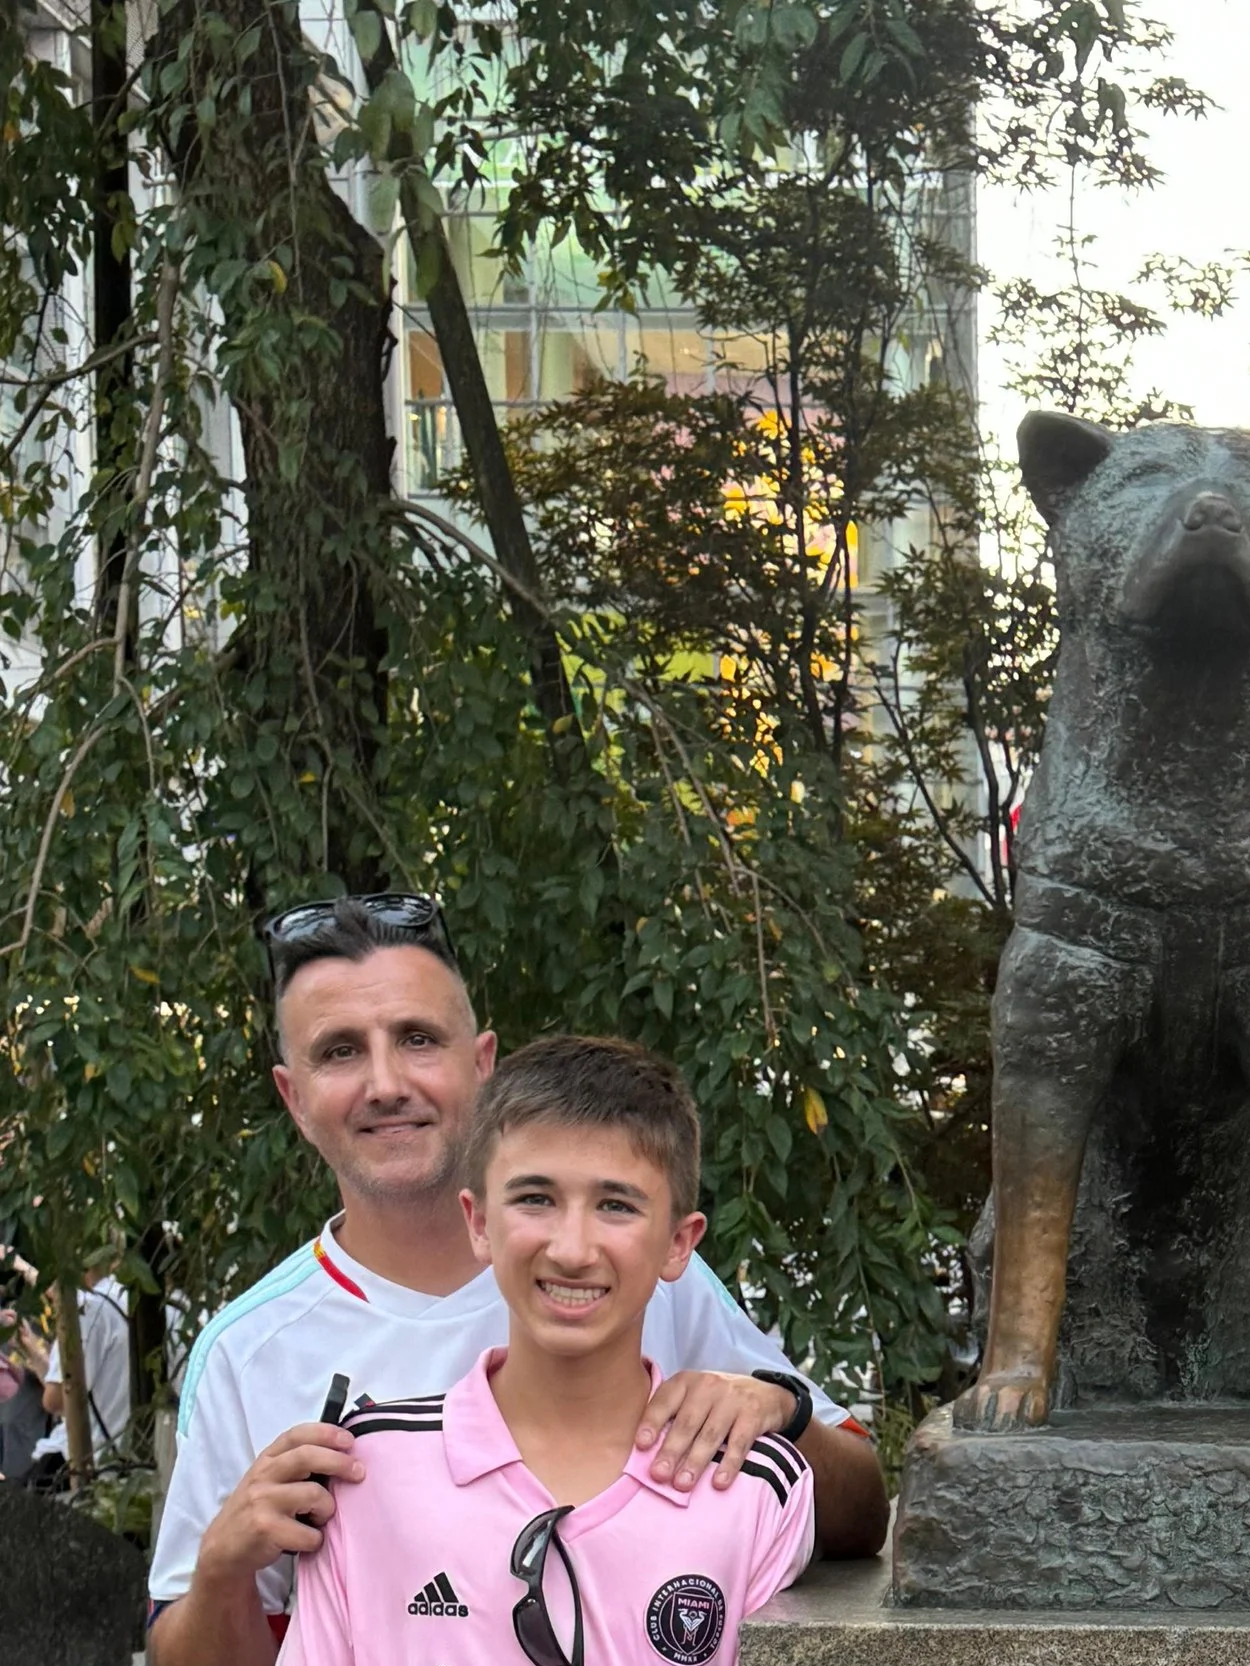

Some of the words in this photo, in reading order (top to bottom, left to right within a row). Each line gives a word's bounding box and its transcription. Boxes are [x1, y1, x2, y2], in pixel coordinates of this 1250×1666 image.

[652, 1578, 720, 1611] INTERNACIONAL
[678, 1597, 710, 1610] MIAMI
[407, 1601, 469, 1618] adidas
[650, 1615, 661, 1641] CLUB
